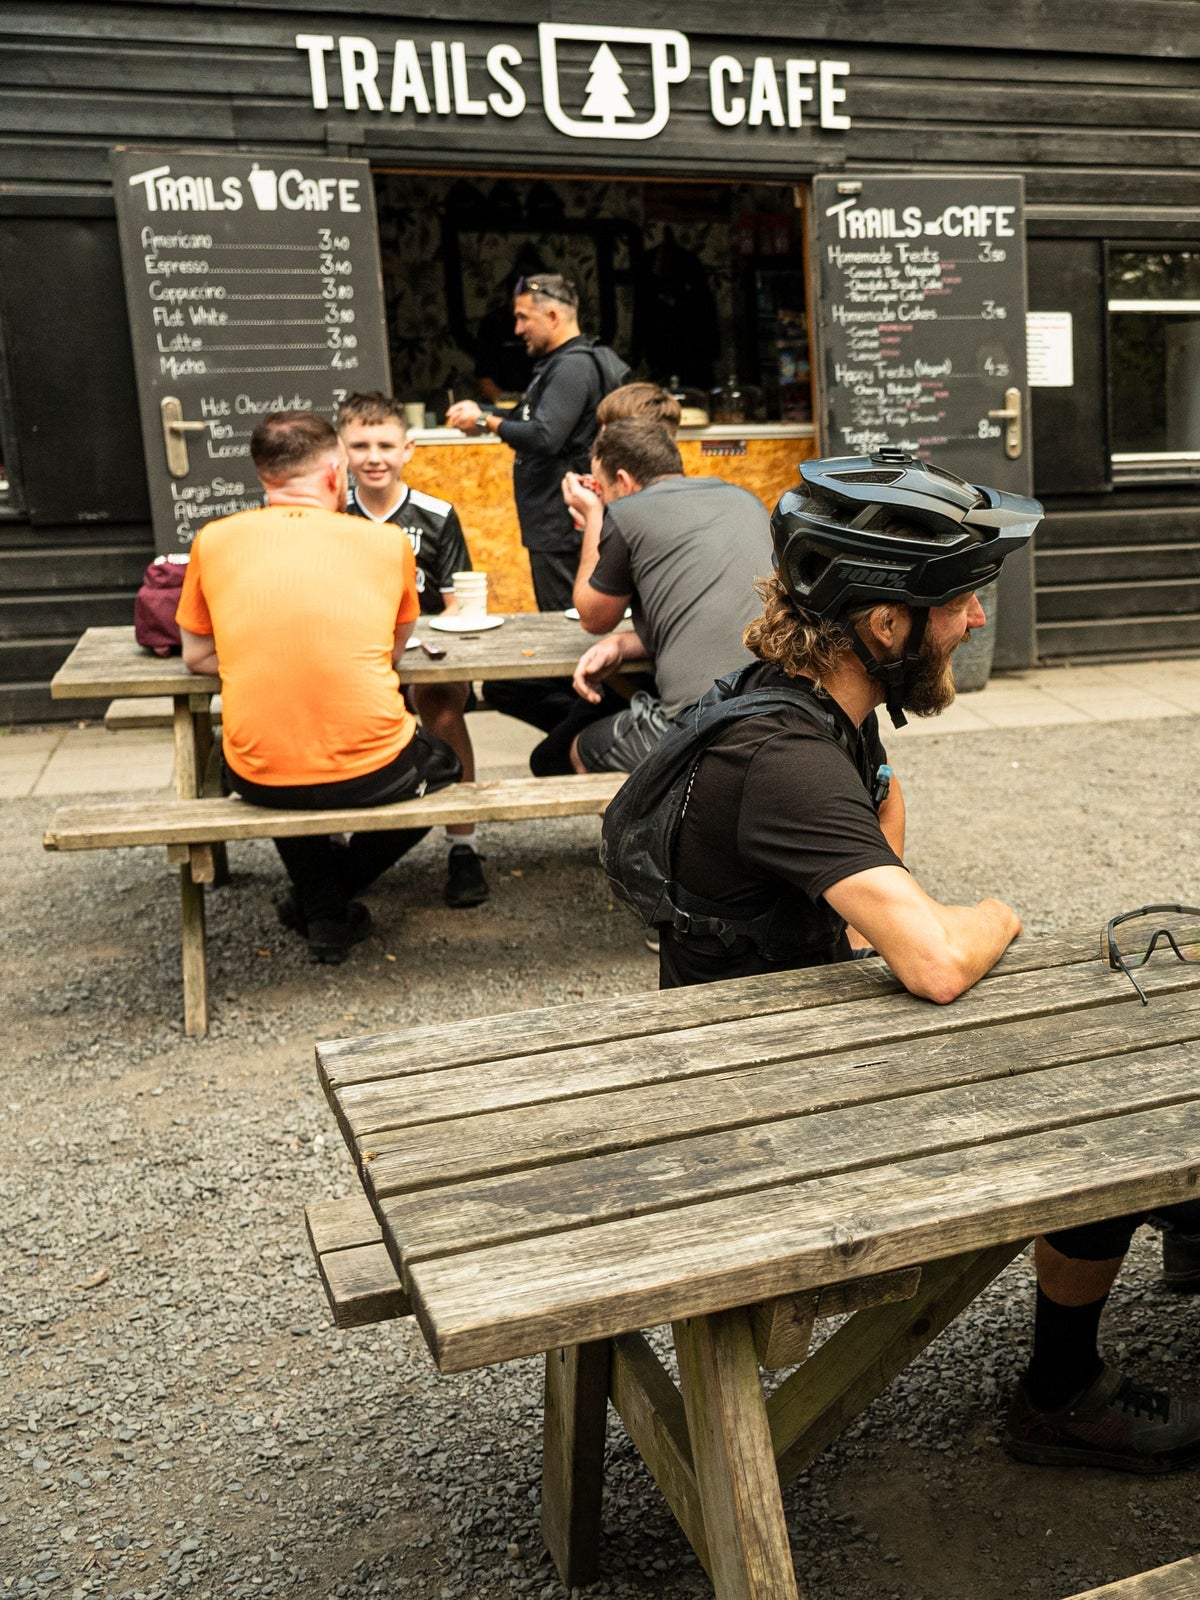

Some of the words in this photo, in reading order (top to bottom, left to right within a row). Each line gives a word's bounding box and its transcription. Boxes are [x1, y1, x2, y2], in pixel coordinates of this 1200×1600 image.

[295, 34, 527, 118] TRAILS
[708, 54, 851, 130] CAFE
[942, 204, 1016, 237] CAFE
[141, 226, 213, 256] Americano
[144, 254, 209, 278] Espresso
[828, 244, 893, 269] Homemade
[894, 243, 940, 264] Treats
[149, 280, 227, 305] Cappuccino
[152, 306, 186, 327] Flat
[188, 305, 229, 326] White
[832, 303, 896, 328] Homemade
[897, 302, 938, 321] Cakes
[156, 332, 203, 353] Latte
[160, 356, 208, 380] Mocha
[834, 363, 875, 388] Happy
[873, 360, 914, 379] Treats
[201, 395, 231, 417] Hot
[235, 393, 312, 415] Chocolate
[204, 419, 233, 440] Tea
[207, 439, 251, 459] Loose
[171, 482, 211, 503] Large
[211, 477, 244, 497] Size
[839, 566, 907, 588] 100%
